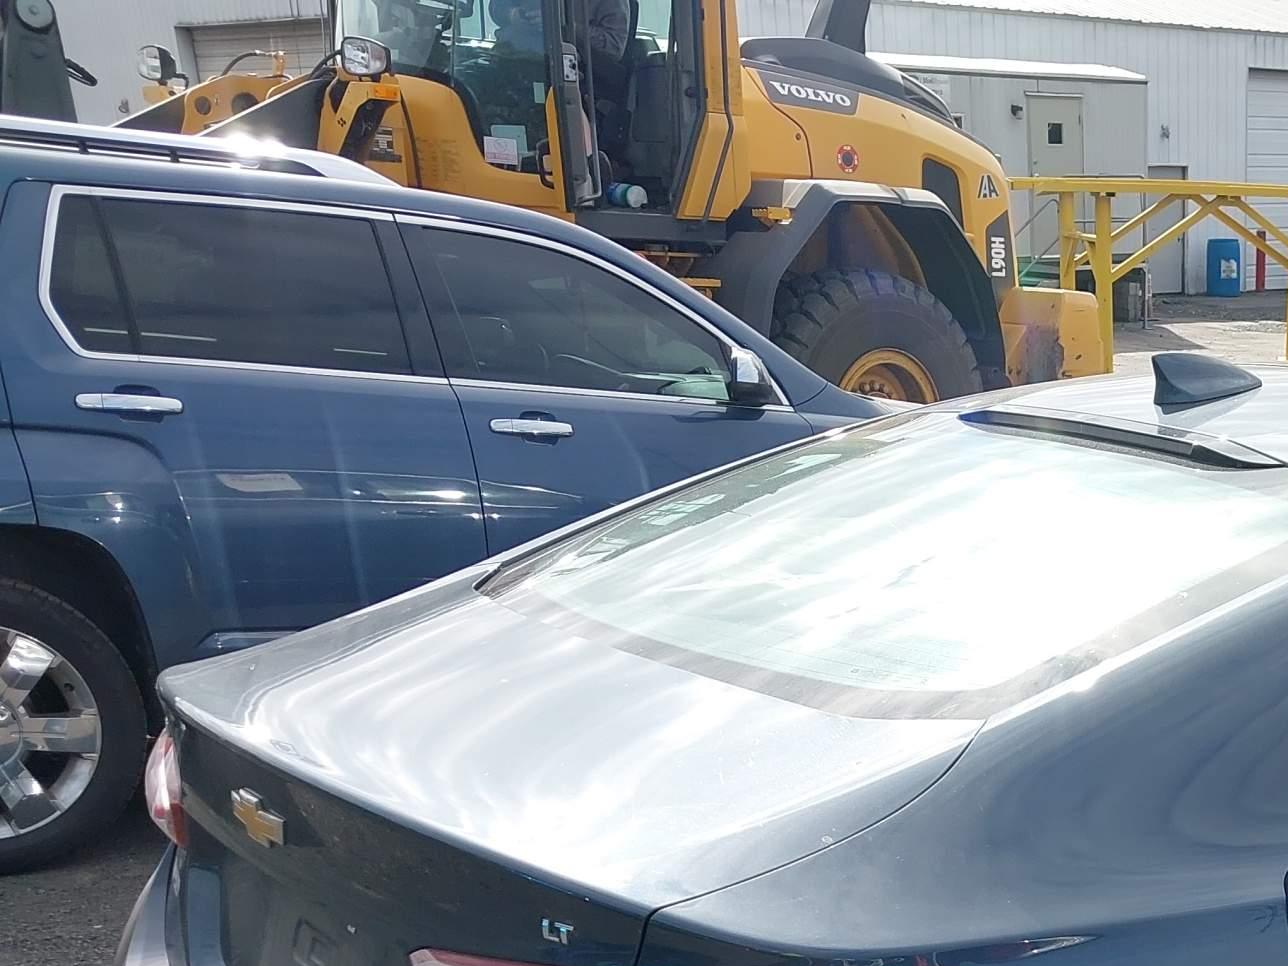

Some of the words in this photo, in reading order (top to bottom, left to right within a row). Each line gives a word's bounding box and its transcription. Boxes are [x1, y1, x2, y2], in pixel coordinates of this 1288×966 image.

[769, 80, 851, 107] VOLVO
[991, 236, 1006, 277] L90H
[542, 918, 574, 945] LT
